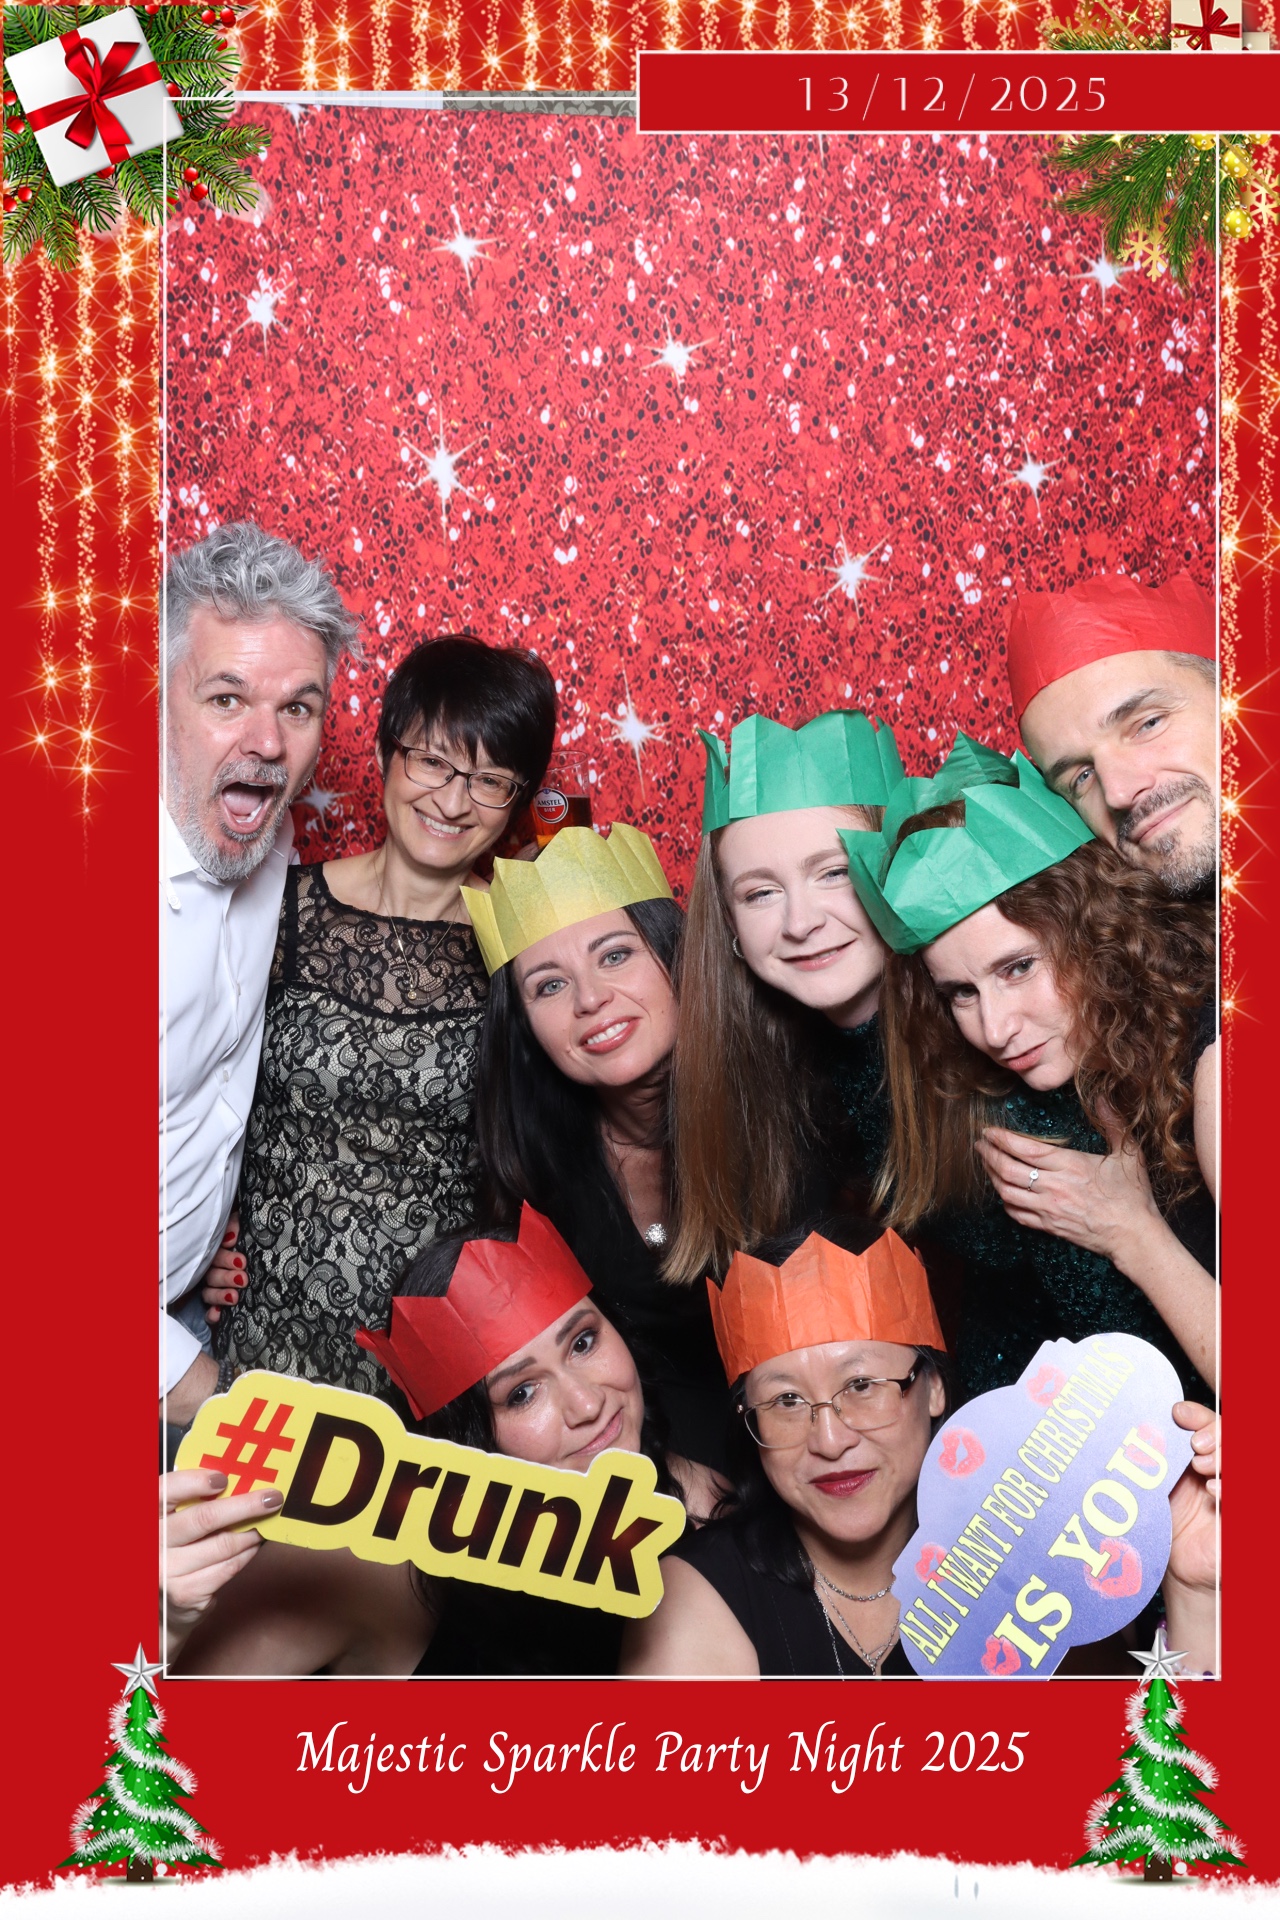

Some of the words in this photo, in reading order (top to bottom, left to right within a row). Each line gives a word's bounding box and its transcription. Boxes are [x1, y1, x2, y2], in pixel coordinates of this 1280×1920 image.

[1017, 1340, 1136, 1484] CHRISTMAS
[199, 1397, 663, 1596] #Drunk
[982, 1467, 1049, 1537] FOR
[936, 1513, 1013, 1599] WANT
[994, 1574, 1073, 1670] IS
[1048, 1427, 1169, 1578] YOU
[899, 1597, 960, 1665] ALL
[927, 1578, 970, 1618] I
